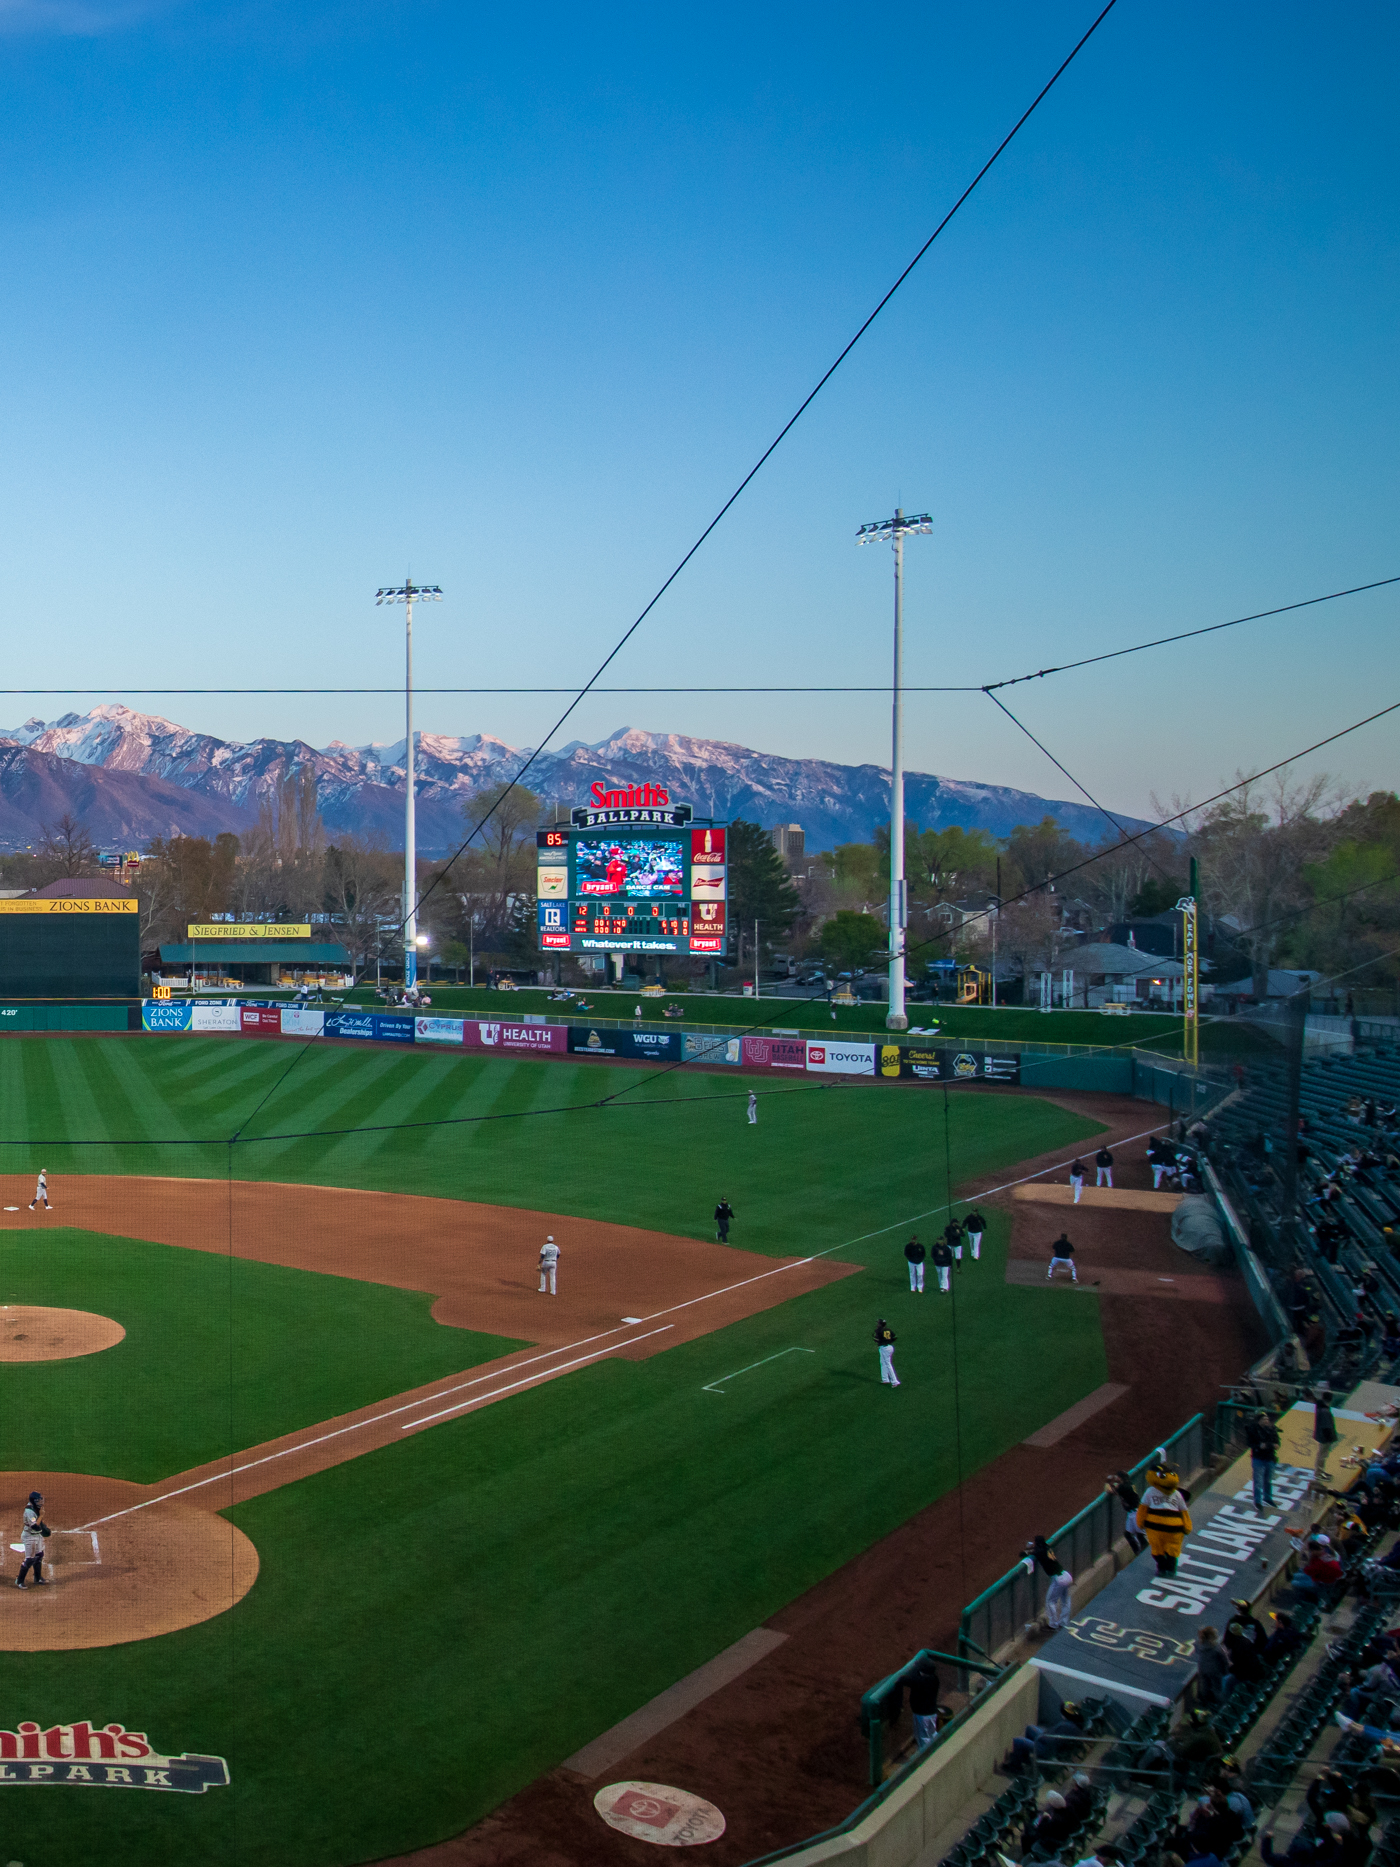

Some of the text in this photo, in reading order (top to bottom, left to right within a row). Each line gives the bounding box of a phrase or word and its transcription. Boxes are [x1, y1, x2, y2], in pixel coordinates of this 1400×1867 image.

[590, 781, 669, 809] Smith's
[586, 811, 675, 826] BALLPARK
[547, 833, 562, 846] 85
[586, 884, 613, 892] bryant
[50, 901, 131, 911] ZIONS BANK
[578, 906, 588, 916] 12
[603, 906, 610, 916] 0
[627, 906, 634, 916] 0
[652, 906, 659, 916] 0
[193, 925, 300, 936] SIEGFRIED & JENSEN
[694, 923, 723, 931] HEALTH
[546, 936, 566, 944] bryant
[581, 939, 633, 949] Whatever
[642, 940, 676, 949] takes.
[693, 940, 716, 948] bryant
[152, 987, 171, 999] 1:00
[1186, 979, 1194, 1008] FOWL
[150, 1008, 183, 1017] ZIONS
[151, 1018, 183, 1026] BANK
[429, 1022, 463, 1031] CYPRUS
[339, 1028, 373, 1036] Dealerships
[503, 1029, 551, 1042] HEALTH
[633, 1034, 657, 1043] WGU
[772, 1044, 804, 1054] UTAH
[829, 1052, 873, 1063] TOYOTA
[909, 1050, 935, 1059] Cheers!
[1185, 1504, 1283, 1562] LAKE
[1136, 1553, 1236, 1616] SALT
[672, 1807, 712, 1845] TOYOTA
